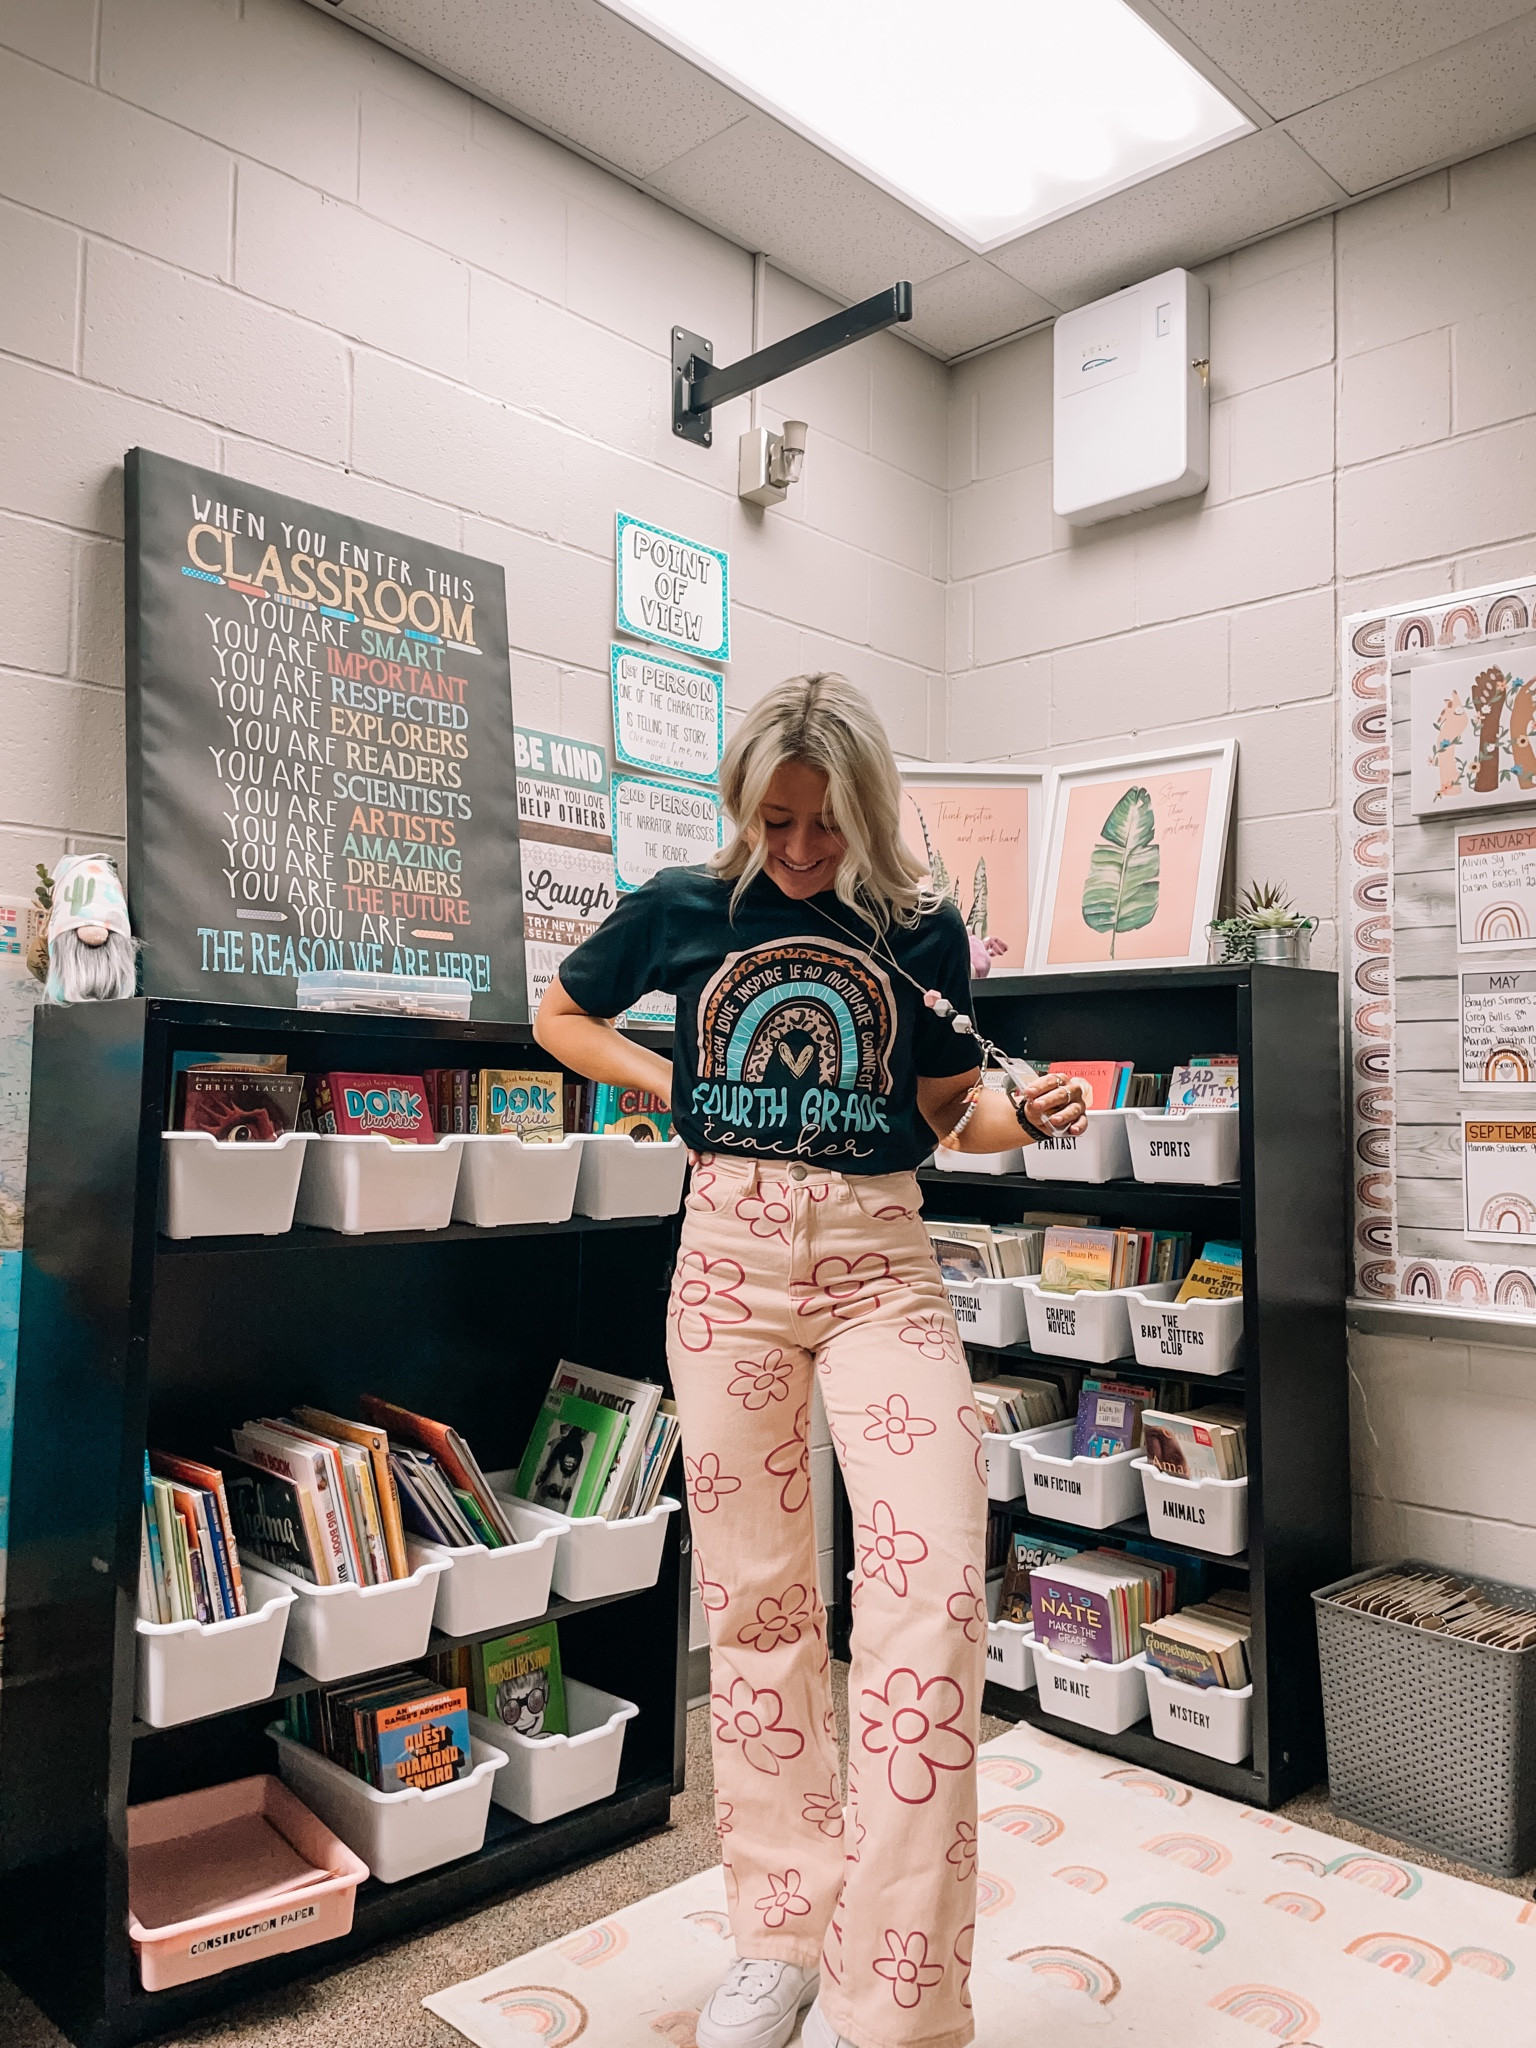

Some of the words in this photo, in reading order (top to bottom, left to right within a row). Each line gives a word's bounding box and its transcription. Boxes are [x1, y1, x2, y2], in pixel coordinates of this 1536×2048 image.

[192, 494, 265, 541] WHEN
[281, 522, 327, 558] YOU
[340, 541, 412, 586] ENTER
[425, 567, 475, 603] THIS
[633, 531, 710, 584] POINT
[187, 524, 476, 646] CLASSROOM
[655, 573, 688, 604] OF
[641, 596, 702, 641] VIEW
[242, 595, 294, 633] YOU
[302, 613, 351, 649] ARE
[361, 629, 445, 672] SMART
[205, 613, 259, 653] YOU
[268, 633, 318, 669] ARE
[327, 646, 468, 704] IMPORTANT
[213, 645, 265, 685] YOU
[273, 663, 323, 700] ARE
[331, 676, 469, 730] RESPECTED
[643, 665, 713, 702] PERSON
[619, 683, 632, 701] ONE
[636, 689, 644, 703] OF
[650, 693, 662, 710] THE
[667, 697, 715, 722] CHARACTERS
[210, 677, 264, 716] YOU
[272, 693, 321, 729] ARE
[331, 707, 469, 759] EXPLORERS
[627, 712, 633, 727] IS
[637, 715, 662, 735] TELLING
[666, 722, 679, 740] THE
[684, 728, 708, 746] STORY.
[227, 715, 279, 754] YOU
[288, 730, 336, 766] ARE
[345, 741, 462, 788] READERS
[646, 738, 666, 748] words
[515, 734, 545, 772] BE
[551, 741, 602, 783] KIND
[209, 746, 264, 785] YOU
[272, 759, 323, 795] ARE
[333, 772, 472, 820] SCIENTISTS
[519, 781, 530, 795] DO
[536, 784, 561, 800] WHAT
[564, 790, 580, 803] YOU
[583, 793, 604, 810] LOVE
[225, 782, 279, 817] YOU
[288, 795, 337, 827] ARE
[349, 806, 456, 846] ARTISTS
[520, 798, 550, 818] HELP
[559, 804, 606, 829] OTHERS
[650, 792, 714, 820] PERSON
[620, 811, 632, 828] THE
[637, 815, 671, 834] NARRATOR
[676, 822, 714, 842] ADDRESSES
[957, 828, 973, 842] and
[999, 828, 1020, 842] hard
[224, 812, 276, 845] YOU
[285, 824, 335, 856] ARE
[341, 833, 462, 873] AMAZING
[645, 842, 657, 858] THE
[662, 845, 689, 863] READER.
[1468, 832, 1534, 851] JANUARY
[222, 839, 276, 872] YOU
[285, 850, 334, 880] ARE
[346, 859, 462, 897] DREAMERS
[1463, 872, 1487, 881] Liam
[222, 868, 278, 901] YOU
[288, 878, 336, 908] ARE
[343, 885, 384, 915] THE
[391, 892, 470, 925] FUTURE
[525, 870, 612, 917] Laugh
[293, 904, 343, 940] YOU
[360, 914, 406, 947] ARE
[527, 916, 549, 928] TRY
[552, 920, 575, 932] NEW
[528, 929, 561, 941] SEIZE
[197, 928, 244, 973] THE
[251, 932, 344, 978] REASON
[350, 941, 382, 973] WE
[391, 945, 430, 976] ARE
[435, 952, 491, 992] HERE!
[1490, 975, 1520, 989] MAY
[715, 1038, 726, 1077] TEACH
[721, 1000, 740, 1034] LOVE
[733, 966, 783, 1003] INSPIRE
[790, 964, 822, 979] LEAD
[825, 971, 874, 1026] MOTIVATE
[858, 1031, 876, 1090] CONNECT
[1466, 1011, 1485, 1026] Greg
[1179, 1068, 1213, 1085] BAD
[344, 1088, 422, 1118] DORK
[491, 1085, 556, 1114] DORK
[1192, 1084, 1239, 1098] KITTY
[360, 1109, 419, 1129] diaries
[501, 1106, 550, 1125] diaries
[691, 1082, 787, 1129] FOURTH
[800, 1088, 889, 1133] GRADE
[704, 1116, 874, 1157] teacher
[1470, 1125, 1536, 1138] SEPTEMBE
[1150, 1141, 1191, 1158] SPORTS
[948, 1231, 968, 1239] MEET
[1046, 1308, 1076, 1323] GRAPHIC
[1048, 1320, 1076, 1336] NOVELS
[1162, 1315, 1178, 1328] THE
[1141, 1325, 1162, 1338] BABY
[1168, 1328, 1204, 1345] SITTERS
[1161, 1342, 1183, 1355] CLUB
[1033, 1473, 1048, 1488] NON
[1051, 1477, 1081, 1496] FICTION
[326, 1511, 337, 1528] BIG
[1163, 1500, 1205, 1525] ANIMALS
[330, 1530, 342, 1557] BOOK
[1017, 1546, 1041, 1567] DOG
[1049, 1588, 1091, 1607] big
[1041, 1597, 1101, 1628] NATE
[1049, 1619, 1078, 1634] MAKES
[1080, 1627, 1096, 1640] THE
[1058, 1633, 1087, 1646] GRADE
[986, 1645, 1003, 1663] MAN
[1054, 1677, 1067, 1691] BIG
[1070, 1680, 1090, 1699] NATE
[420, 1699, 461, 1715] ADVENTURE
[1169, 1703, 1210, 1729] MYSTERY
[405, 1726, 446, 1753] QUEST
[396, 1746, 458, 1778] DIAMOND
[406, 1764, 453, 1788] SWORD
[191, 1918, 276, 1955] CONSTRUCTION
[281, 1906, 315, 1925] PAPER
